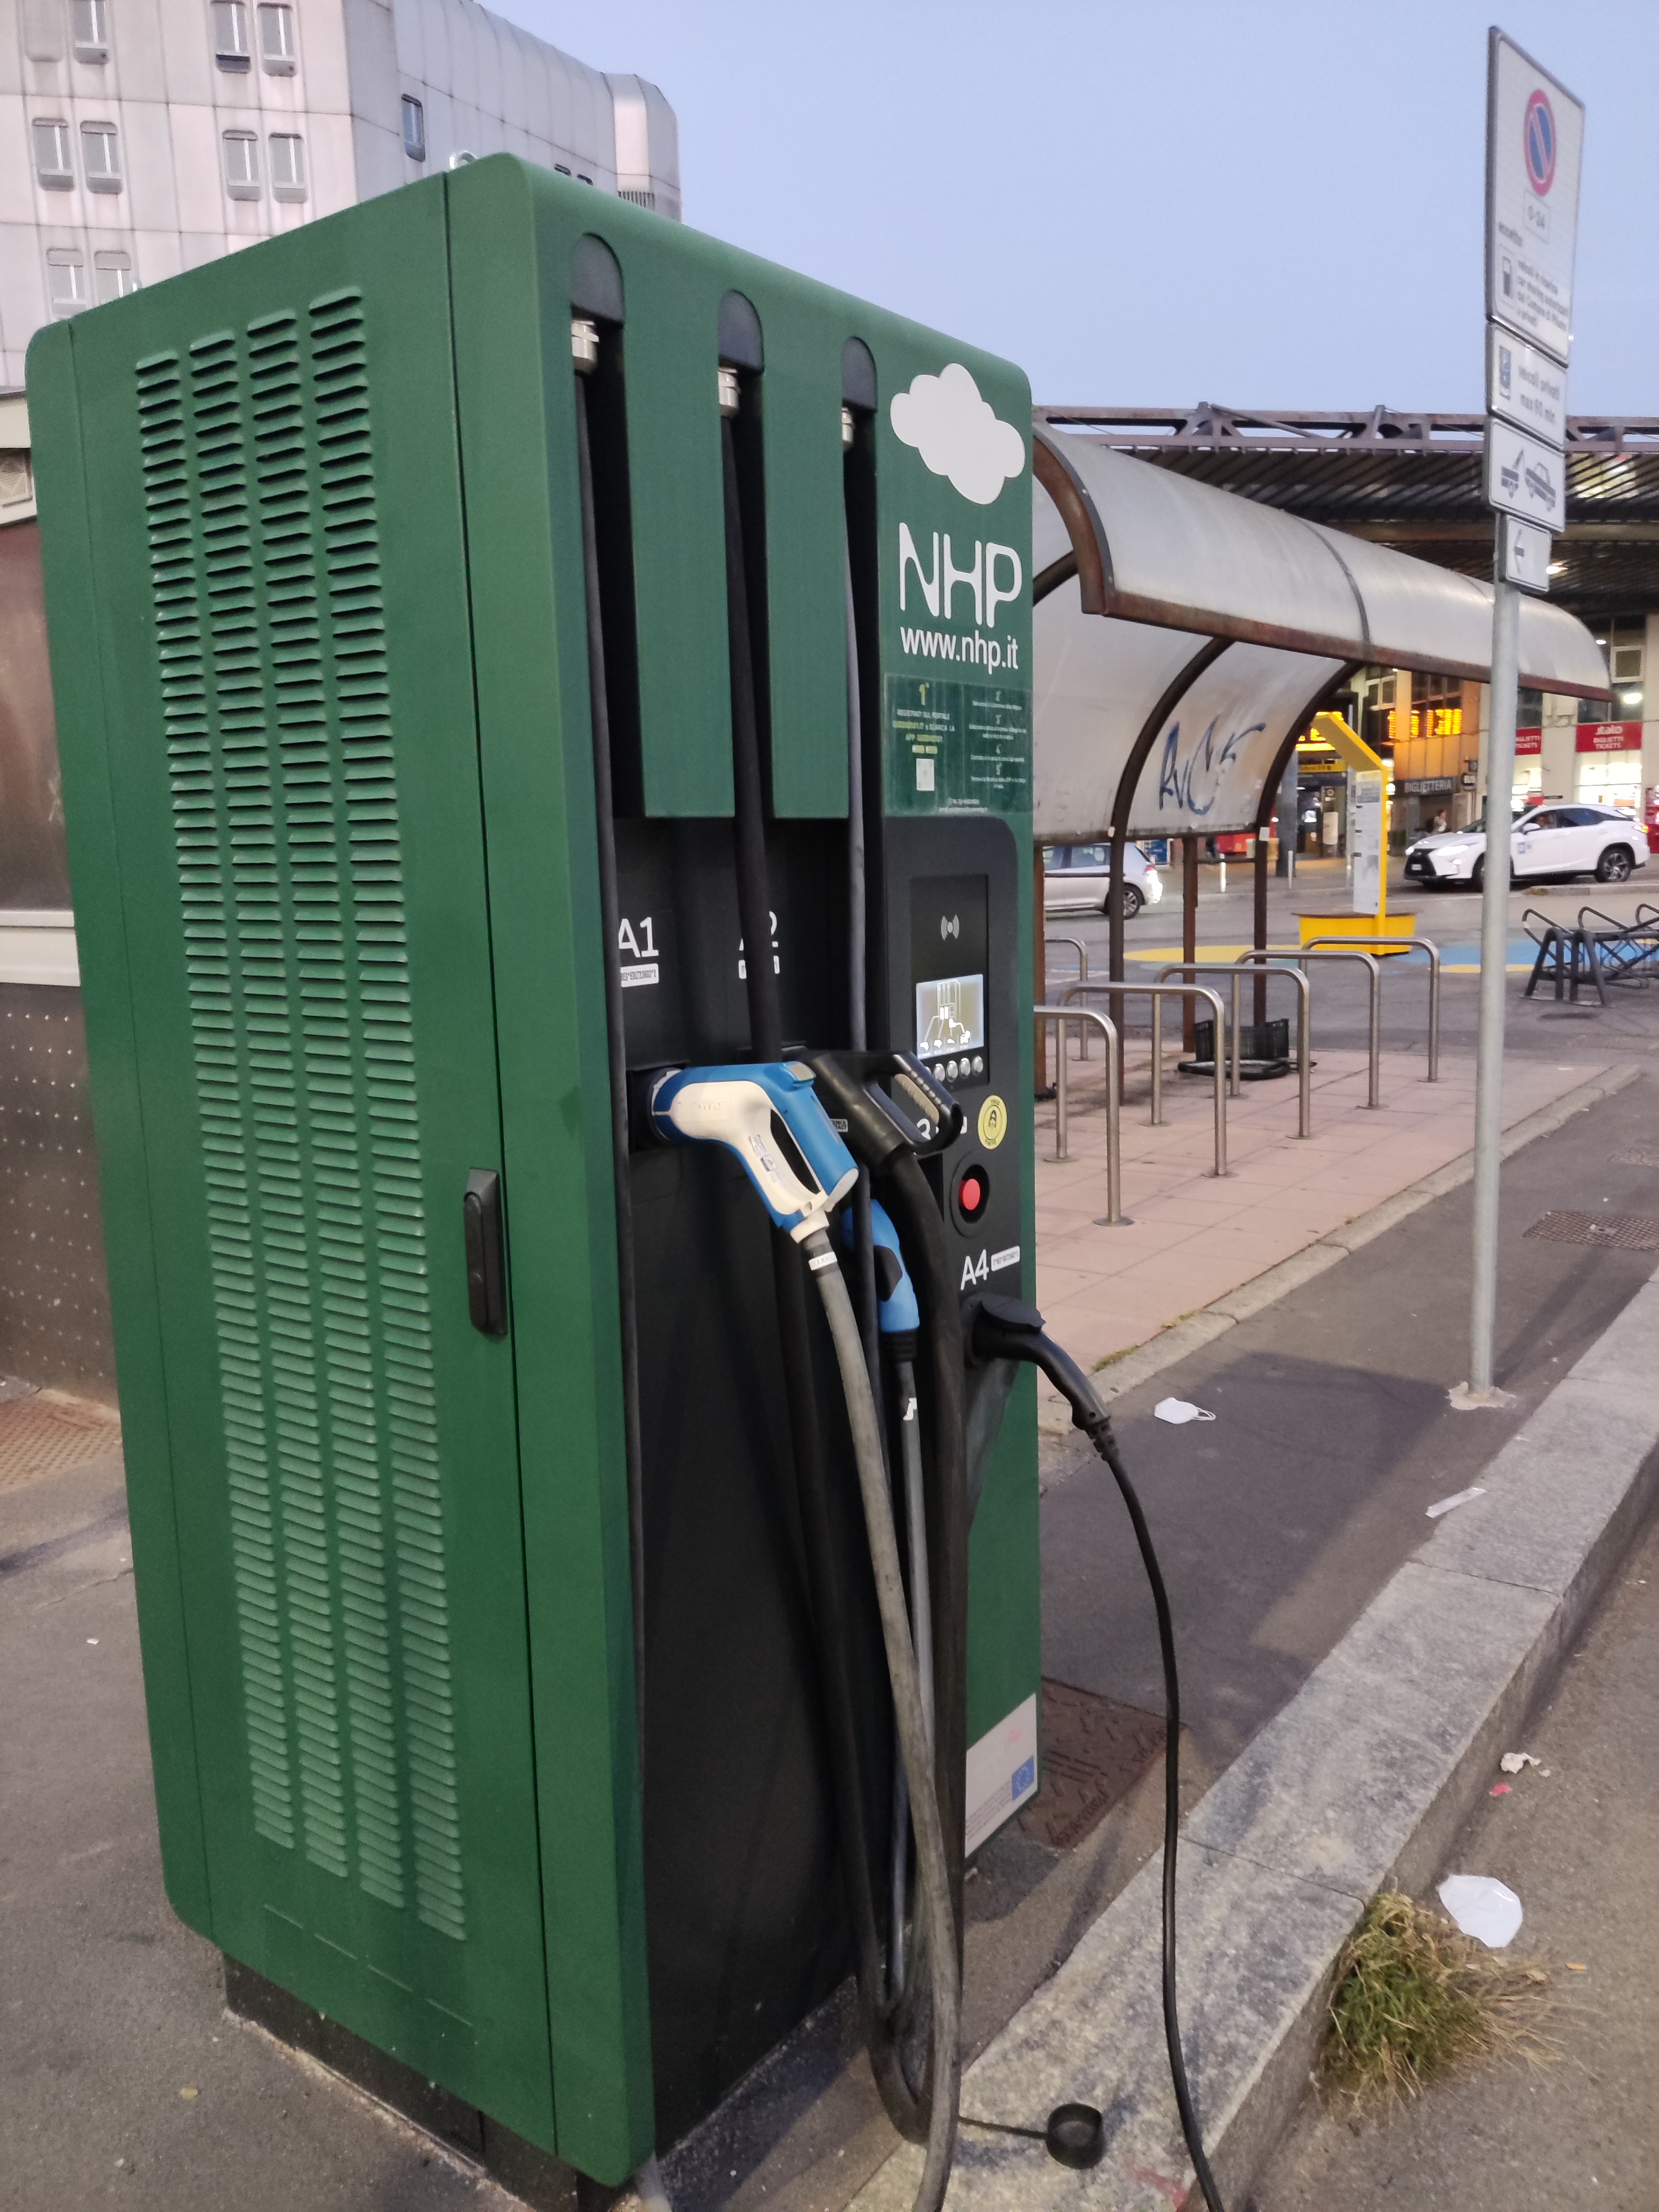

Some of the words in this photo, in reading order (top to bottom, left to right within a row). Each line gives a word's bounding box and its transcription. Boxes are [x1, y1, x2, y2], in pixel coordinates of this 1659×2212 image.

[899, 523, 1022, 628] NHP
[900, 627, 1019, 674] www.nhp.it
[1405, 779, 1451, 793] BIGLIETTERIA
[618, 916, 659, 958] A1
[960, 1249, 989, 1291] A4
